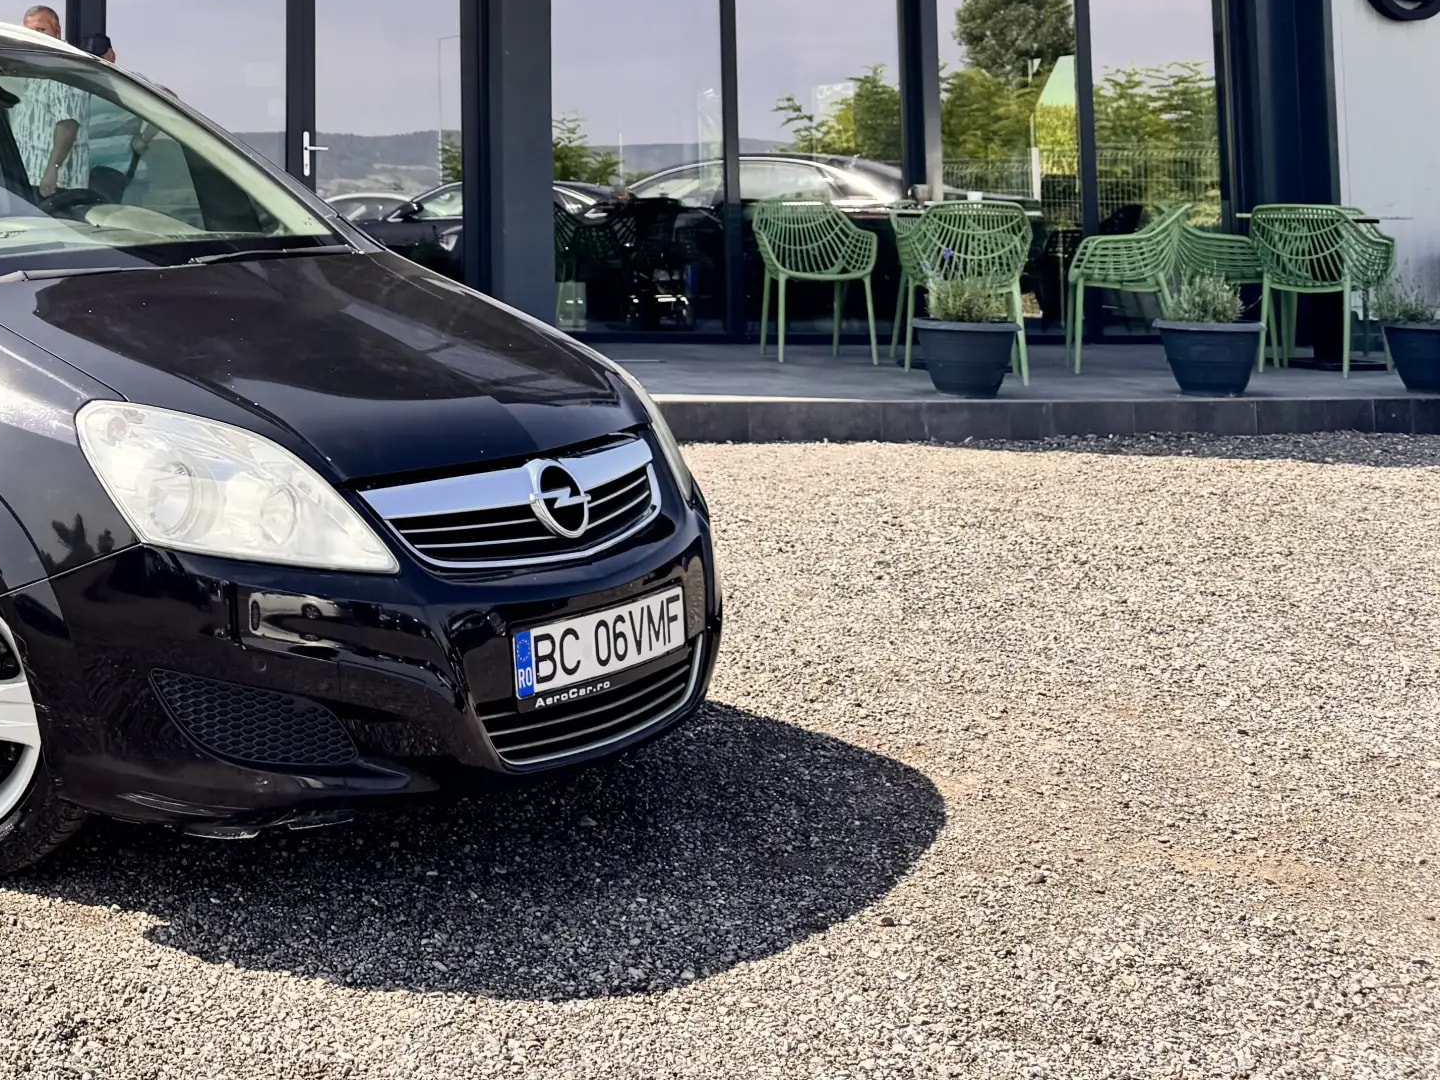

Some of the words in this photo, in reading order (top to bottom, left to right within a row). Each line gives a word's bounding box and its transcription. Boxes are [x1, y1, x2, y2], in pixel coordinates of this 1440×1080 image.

[533, 628, 581, 684] BC
[517, 667, 533, 689] RO
[535, 681, 611, 709] AeroCar.ro
